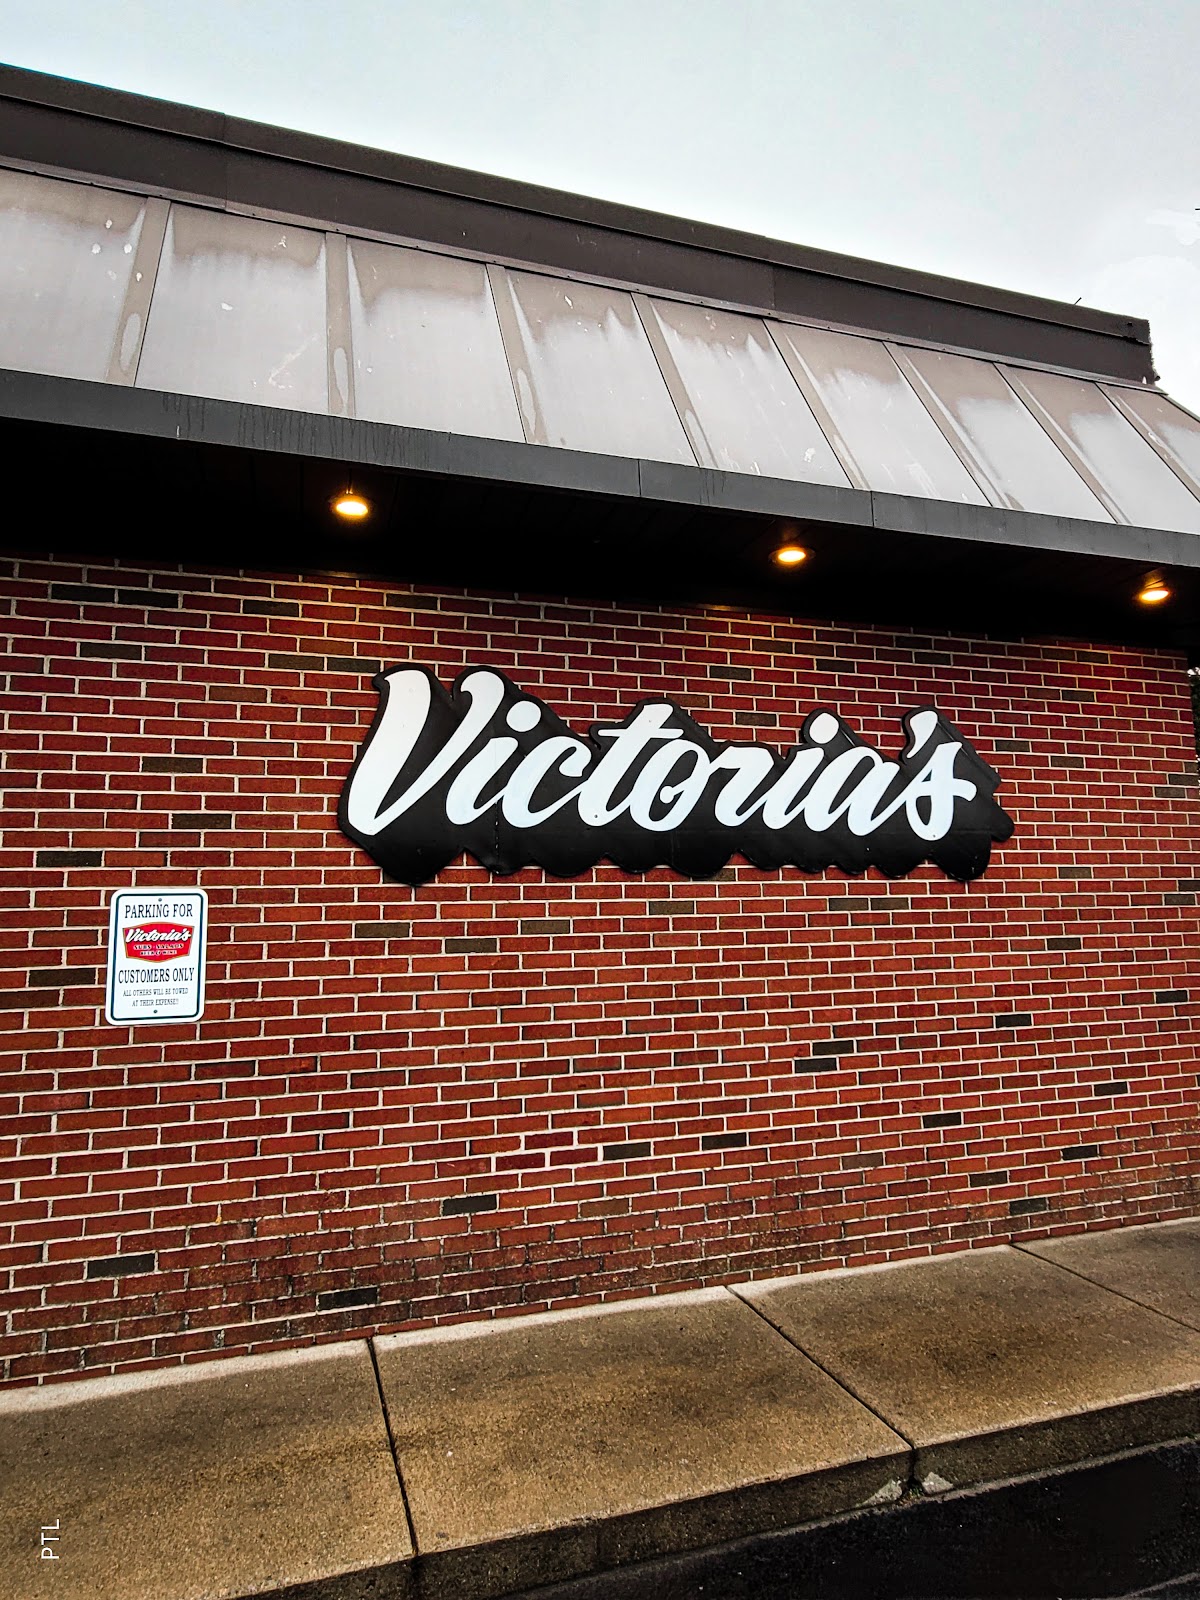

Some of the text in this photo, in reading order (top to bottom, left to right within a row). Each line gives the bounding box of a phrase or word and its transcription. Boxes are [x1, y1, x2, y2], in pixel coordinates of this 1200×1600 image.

[346, 665, 977, 840] Victoria's
[125, 903, 193, 918] PARKING FOR
[126, 928, 191, 943] Victoria's
[118, 967, 195, 984] CUSTOMERS ONLY
